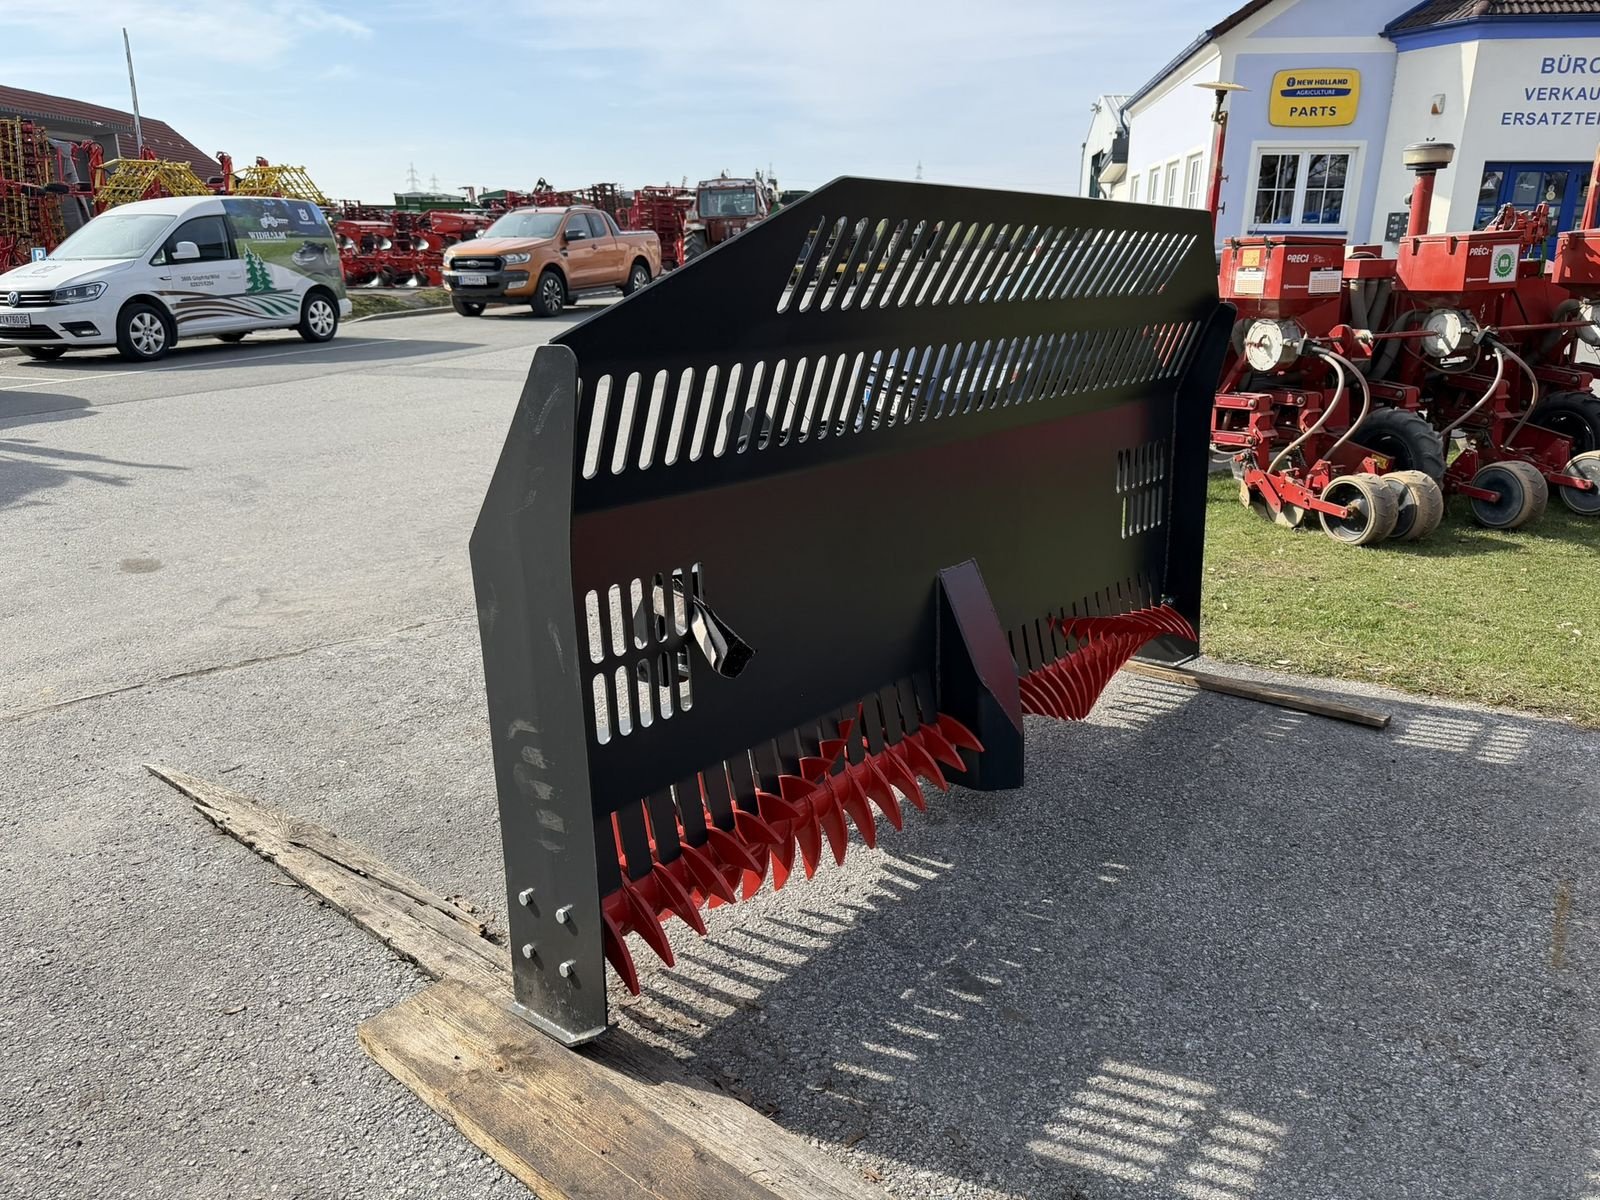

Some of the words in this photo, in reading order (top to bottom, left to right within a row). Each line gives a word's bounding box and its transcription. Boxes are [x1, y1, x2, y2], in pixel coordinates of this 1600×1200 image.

[1525, 87, 1600, 101] VERKAU
[1289, 106, 1337, 117] PARTS
[248, 231, 287, 240] WIDHALM
